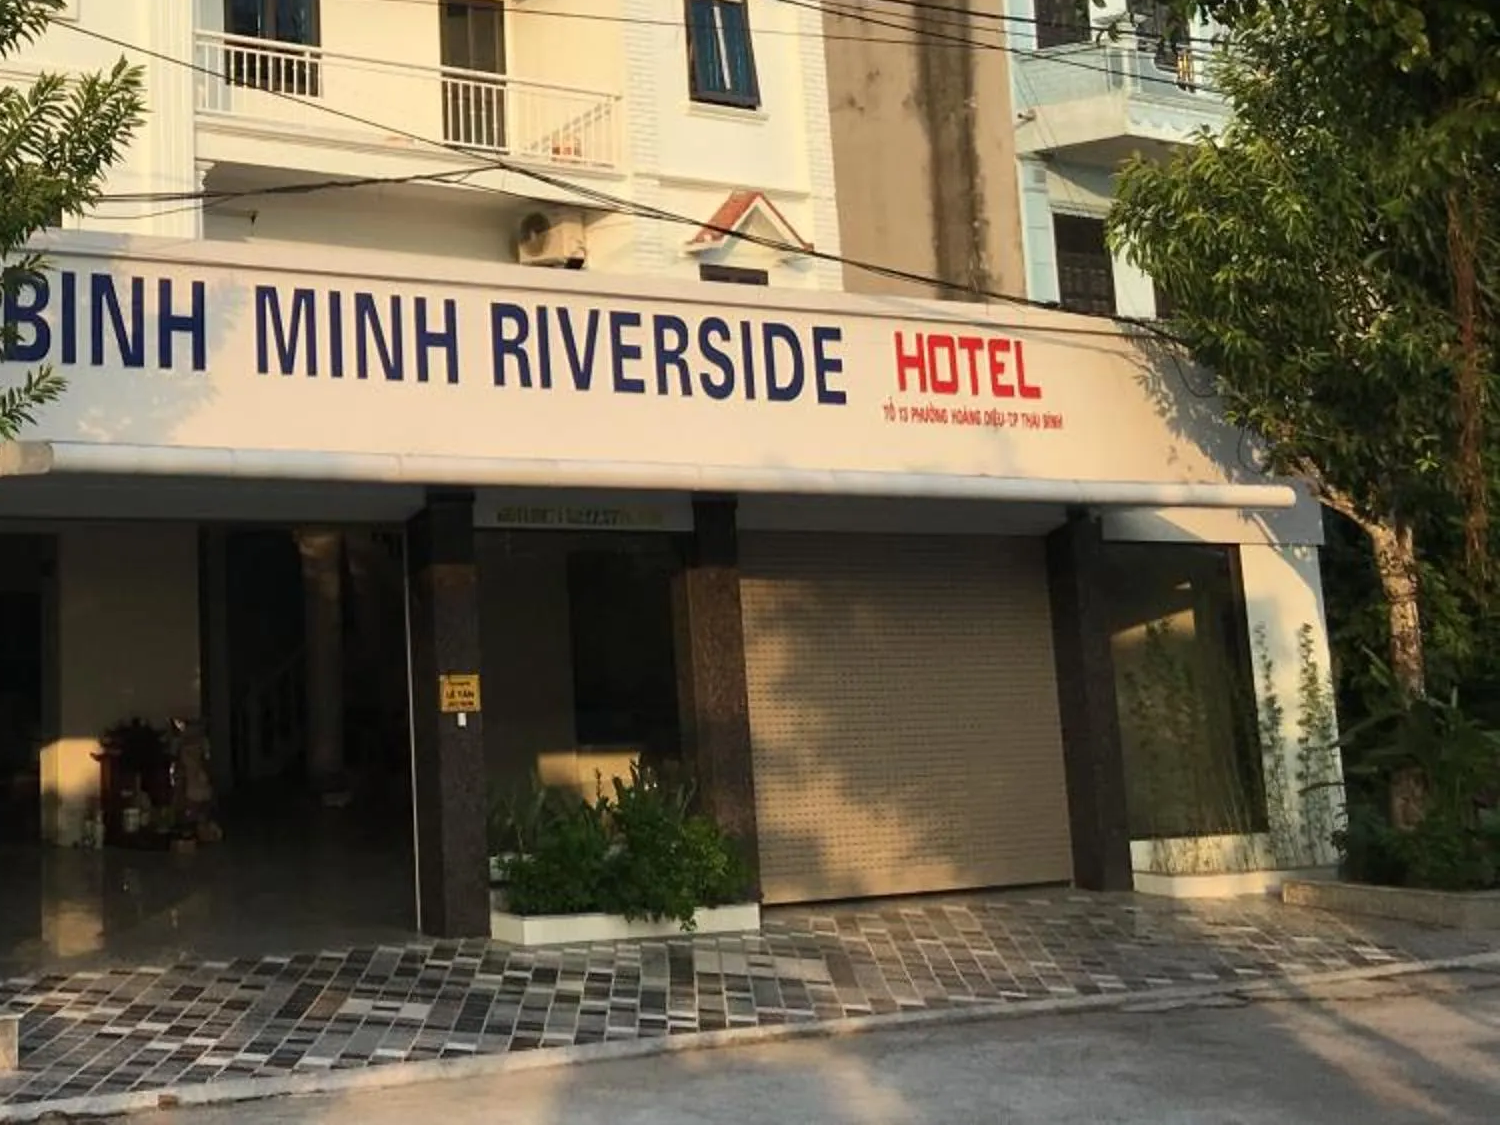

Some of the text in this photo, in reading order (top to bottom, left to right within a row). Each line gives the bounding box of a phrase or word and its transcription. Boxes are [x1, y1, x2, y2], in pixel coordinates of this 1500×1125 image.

[2, 264, 848, 405] BINH MINH RIVERSIDE
[894, 330, 1043, 400] HOTEL
